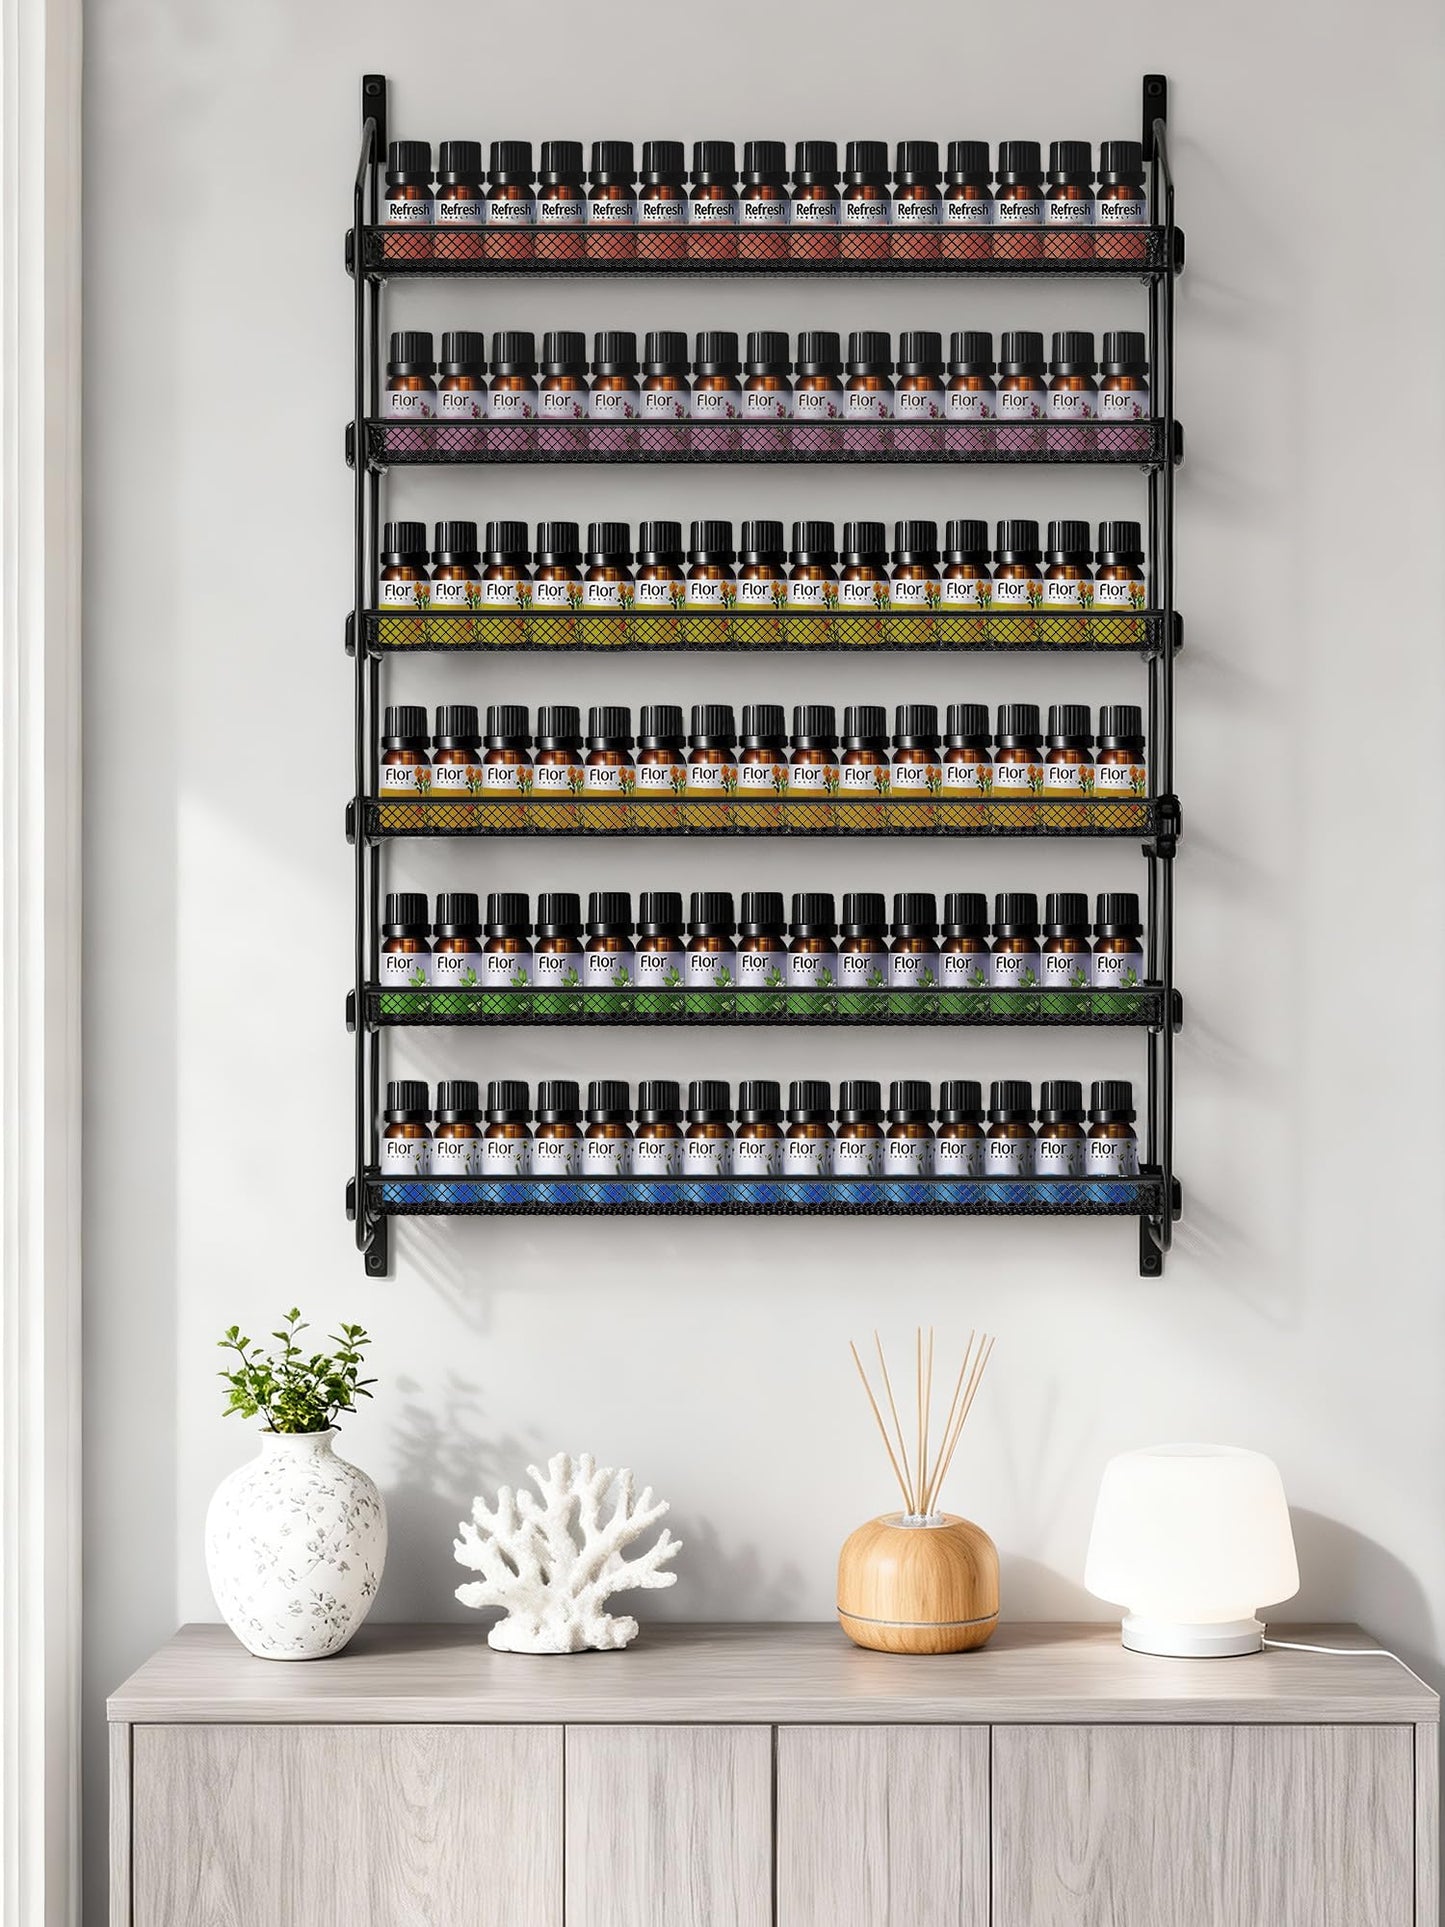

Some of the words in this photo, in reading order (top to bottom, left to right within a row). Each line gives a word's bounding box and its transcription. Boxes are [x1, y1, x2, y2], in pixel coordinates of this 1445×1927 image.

[389, 204, 430, 215] Refresh
[440, 204, 481, 215] Refresh
[491, 204, 531, 215] Refresh
[541, 204, 582, 215] Refresh
[592, 204, 633, 215] Refresh
[643, 204, 684, 215] Refresh
[694, 204, 734, 215] Refresh
[744, 204, 785, 215] Refresh
[796, 204, 836, 215] Refresh
[846, 204, 887, 215] Refresh
[897, 204, 938, 215] Refresh
[948, 204, 989, 215] Refresh
[999, 204, 1040, 215] Refresh
[1050, 204, 1091, 215] Refresh
[1101, 204, 1142, 215] Refresh
[392, 394, 418, 406] Flor
[442, 394, 469, 406] Flor
[493, 394, 520, 406] Flor
[544, 394, 571, 406] Flor
[595, 394, 622, 406] Flor
[646, 394, 673, 406] Flor
[697, 394, 724, 406] Flor
[748, 394, 774, 406] Flor
[799, 394, 825, 406] Flor
[849, 394, 876, 406] Flor
[900, 394, 927, 406] Flor
[951, 394, 978, 406] Flor
[1002, 394, 1029, 406] Flor
[1053, 394, 1080, 406] Flor
[1104, 394, 1130, 406] Flor
[385, 584, 412, 596] Flor
[436, 584, 463, 596] Flor
[487, 584, 514, 596] Flor
[538, 584, 565, 596] Flor
[588, 584, 616, 596] Flor
[640, 584, 667, 596] Flor
[691, 583, 718, 595] Flor
[742, 583, 769, 595] Flor
[793, 584, 820, 596] Flor
[844, 584, 871, 596] Flor
[895, 583, 923, 595] Flor
[946, 582, 974, 594] Flor
[997, 582, 1025, 594] Flor
[1048, 583, 1076, 595] Flor
[1099, 584, 1127, 596] Flor
[385, 768, 413, 780] Flor
[436, 768, 464, 780] Flor
[487, 768, 515, 780] Flor
[538, 768, 566, 780] Flor
[589, 769, 617, 781] Flor
[641, 768, 668, 780] Flor
[692, 767, 719, 779] Flor
[742, 767, 770, 779] Flor
[793, 768, 821, 780] Flor
[844, 768, 872, 780] Flor
[896, 767, 923, 779] Flor
[947, 766, 974, 778] Flor
[998, 766, 1025, 778] Flor
[1049, 767, 1076, 779] Flor
[1100, 768, 1127, 780] Flor
[386, 956, 413, 968] Flor
[437, 956, 464, 968] Flor
[488, 956, 515, 968] Flor
[538, 956, 566, 968] Flor
[589, 955, 617, 967] Flor
[640, 955, 667, 967] Flor
[691, 955, 718, 967] Flor
[742, 955, 769, 967] Flor
[792, 956, 820, 968] Flor
[843, 956, 870, 968] Flor
[894, 956, 921, 968] Flor
[945, 956, 972, 968] Flor
[996, 956, 1023, 968] Flor
[1046, 956, 1074, 968] Flor
[1097, 956, 1124, 968] Flor
[387, 1142, 414, 1154] Flor
[437, 1142, 464, 1154] Flor
[487, 1142, 514, 1154] Flor
[538, 1142, 565, 1154] Flor
[588, 1142, 615, 1154] Flor
[638, 1142, 665, 1154] Flor
[689, 1142, 716, 1154] Flor
[739, 1142, 766, 1154] Flor
[789, 1142, 816, 1154] Flor
[839, 1142, 866, 1154] Flor
[890, 1142, 917, 1154] Flor
[940, 1142, 967, 1154] Flor
[990, 1142, 1017, 1154] Flor
[1041, 1142, 1068, 1154] Flor
[1091, 1142, 1118, 1154] Flor
